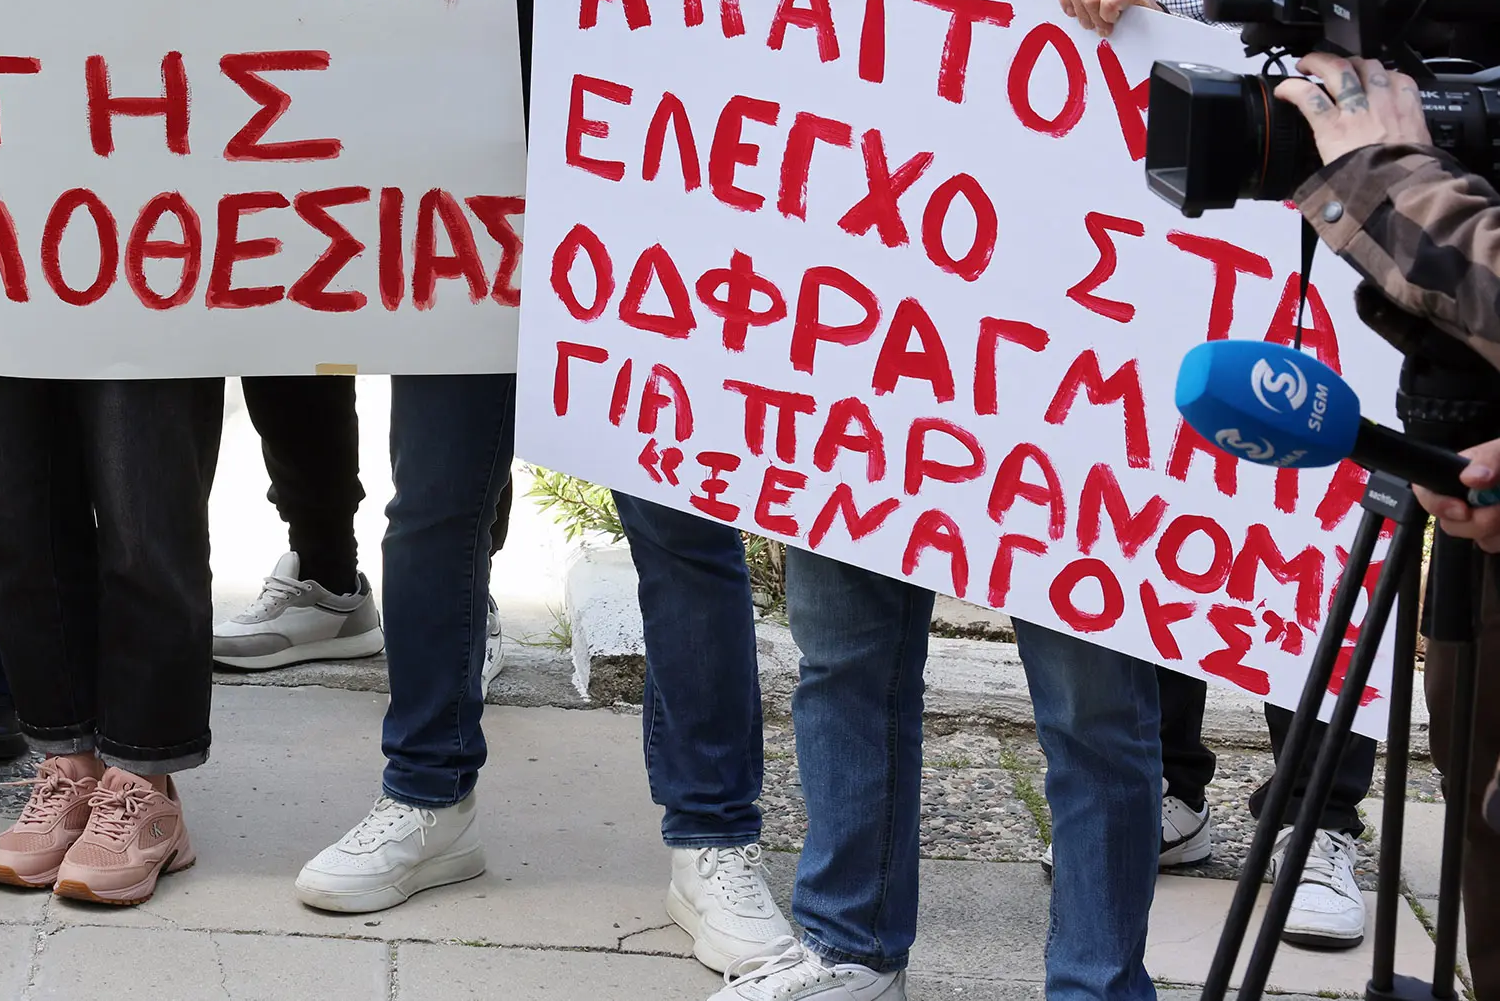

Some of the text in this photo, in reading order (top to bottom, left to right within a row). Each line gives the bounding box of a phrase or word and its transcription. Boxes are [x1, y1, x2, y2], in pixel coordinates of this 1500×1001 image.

[565, 73, 1342, 376] ΕΛΕΓΧΟ ΣΤΑ
[553, 341, 694, 443] ΓΙΑ
